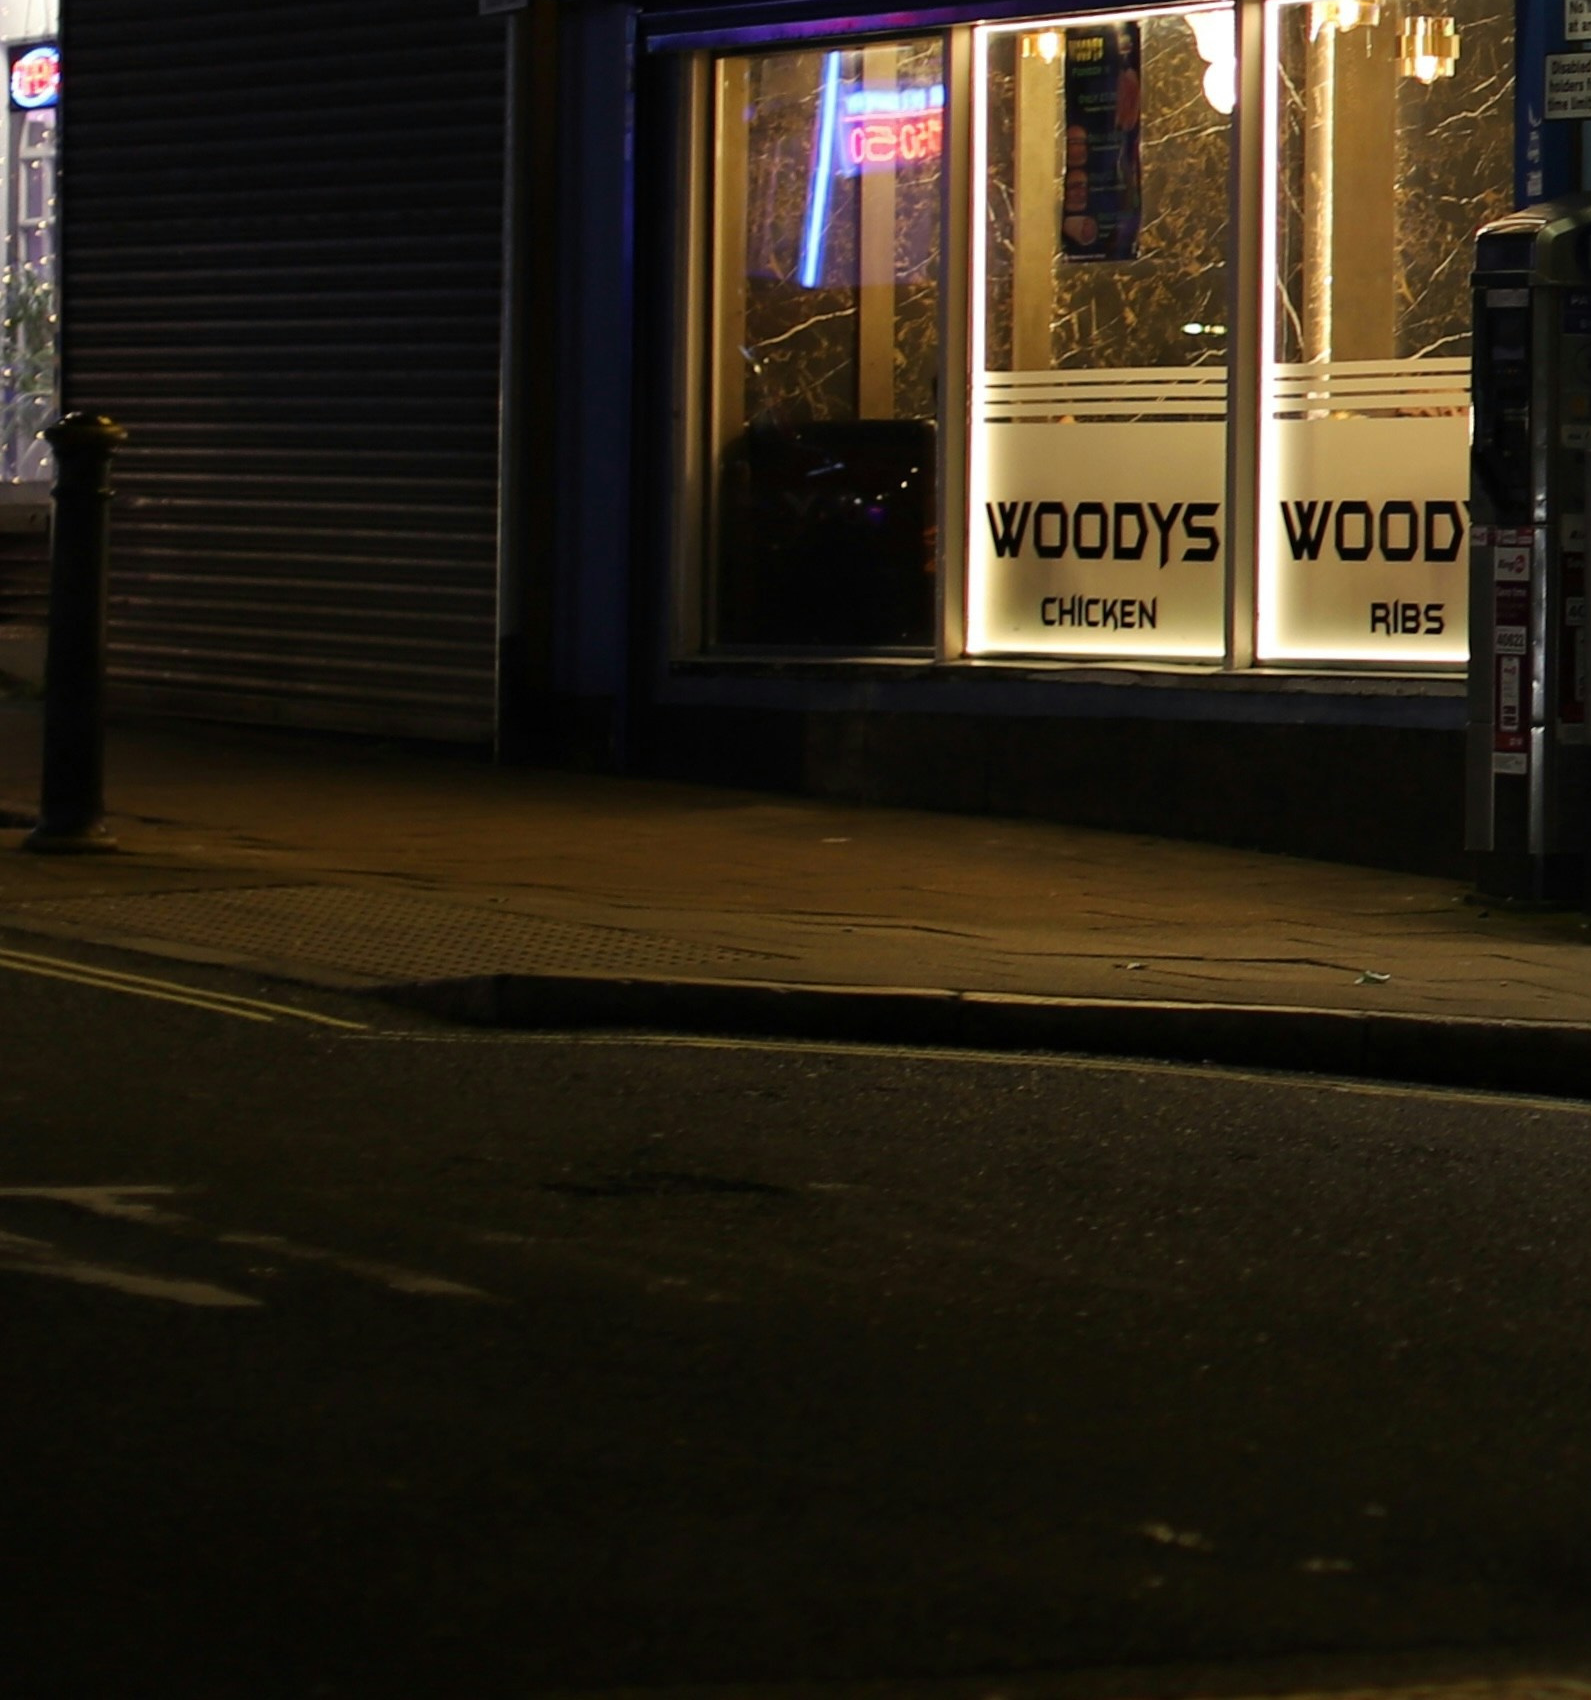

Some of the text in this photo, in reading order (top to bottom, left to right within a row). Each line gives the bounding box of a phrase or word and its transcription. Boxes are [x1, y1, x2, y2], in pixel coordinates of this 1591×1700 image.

[1568, 0, 1584, 14] No
[1567, 20, 1579, 33] at
[1551, 60, 1591, 75] Disabled
[985, 500, 1221, 570] WOODYS
[1279, 500, 1470, 564] WOOD
[1040, 595, 1158, 633] CHICKEN
[1370, 599, 1447, 639] RIBS
